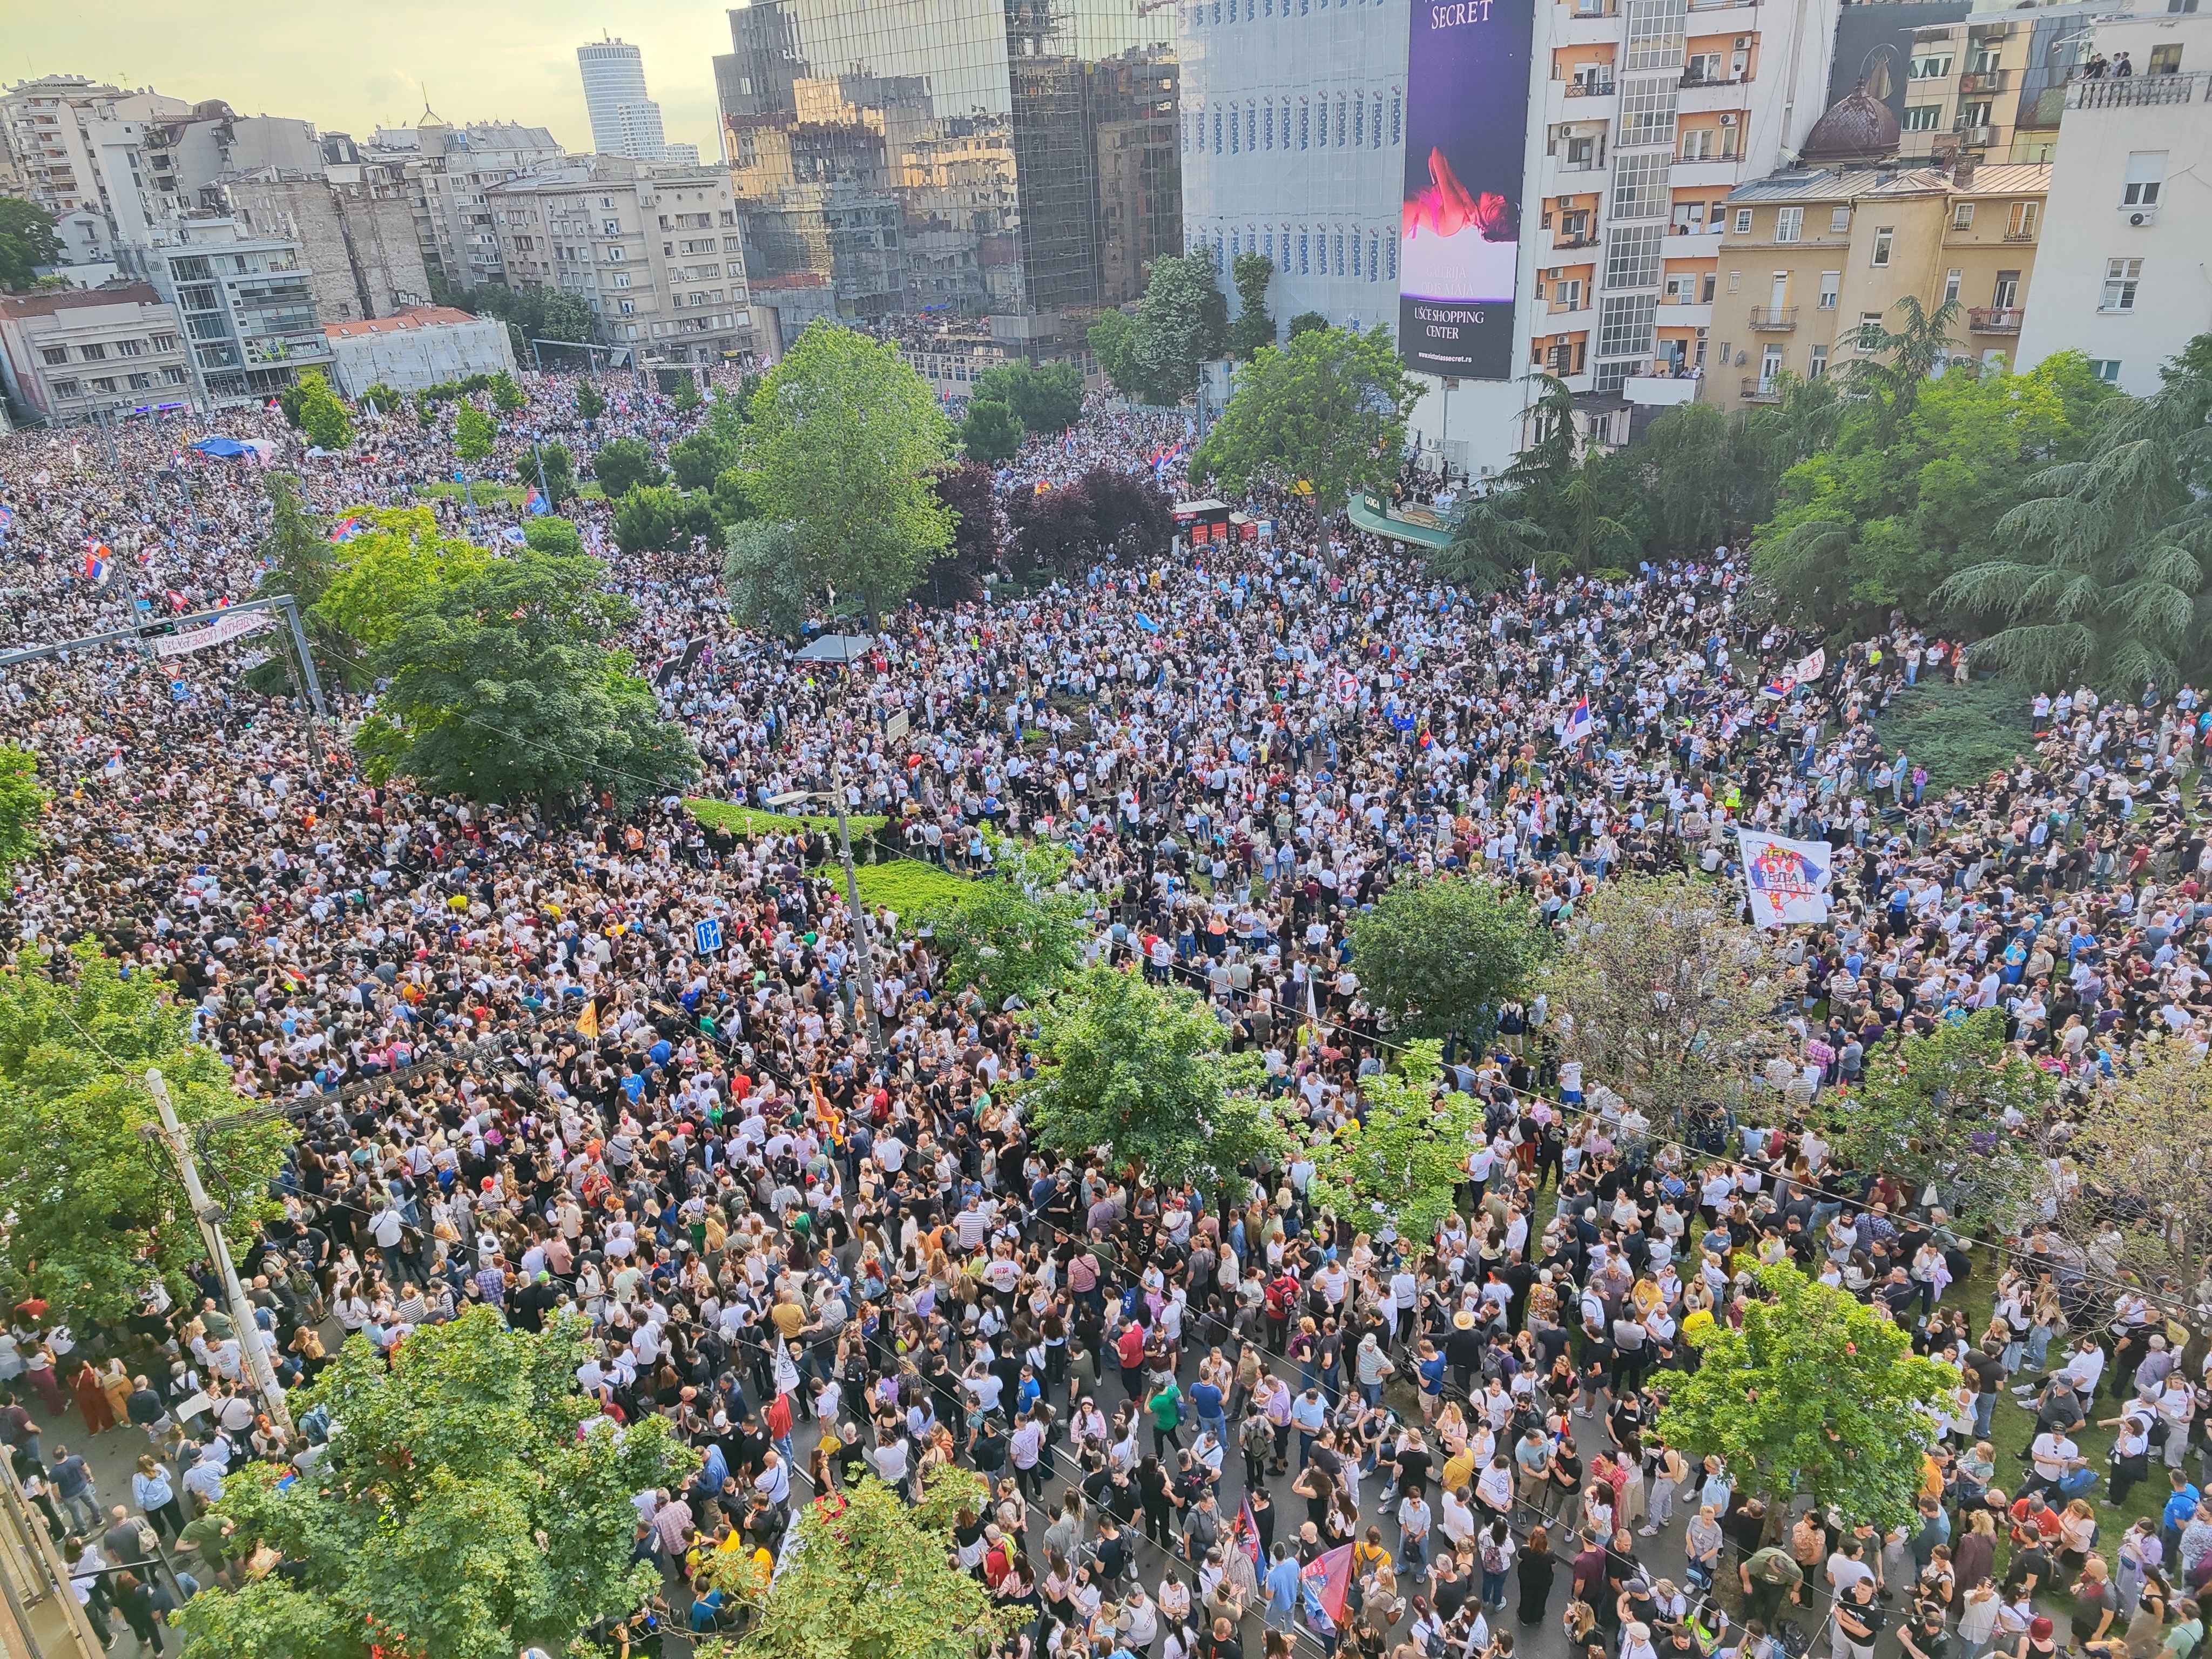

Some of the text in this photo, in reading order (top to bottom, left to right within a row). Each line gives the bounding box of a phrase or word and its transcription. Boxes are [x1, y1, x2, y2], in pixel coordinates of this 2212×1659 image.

[1432, 0, 1493, 29] SECRET
[1320, 103, 1328, 147] ROMA
[1355, 101, 1364, 146] ROMA
[1373, 104, 1382, 150] ROMA
[1392, 98, 1401, 146] ROMA
[1319, 234, 1327, 275] ROMA
[1427, 266, 1466, 281] GALERIJA
[1421, 282, 1474, 298] OD 15. MAJA
[1414, 306, 1485, 323] UŠĆE SHOPPING
[1426, 325, 1459, 339] CENTER
[1418, 351, 1472, 363] www.victoriassecret.rs
[1365, 495, 1380, 509] GOGA
